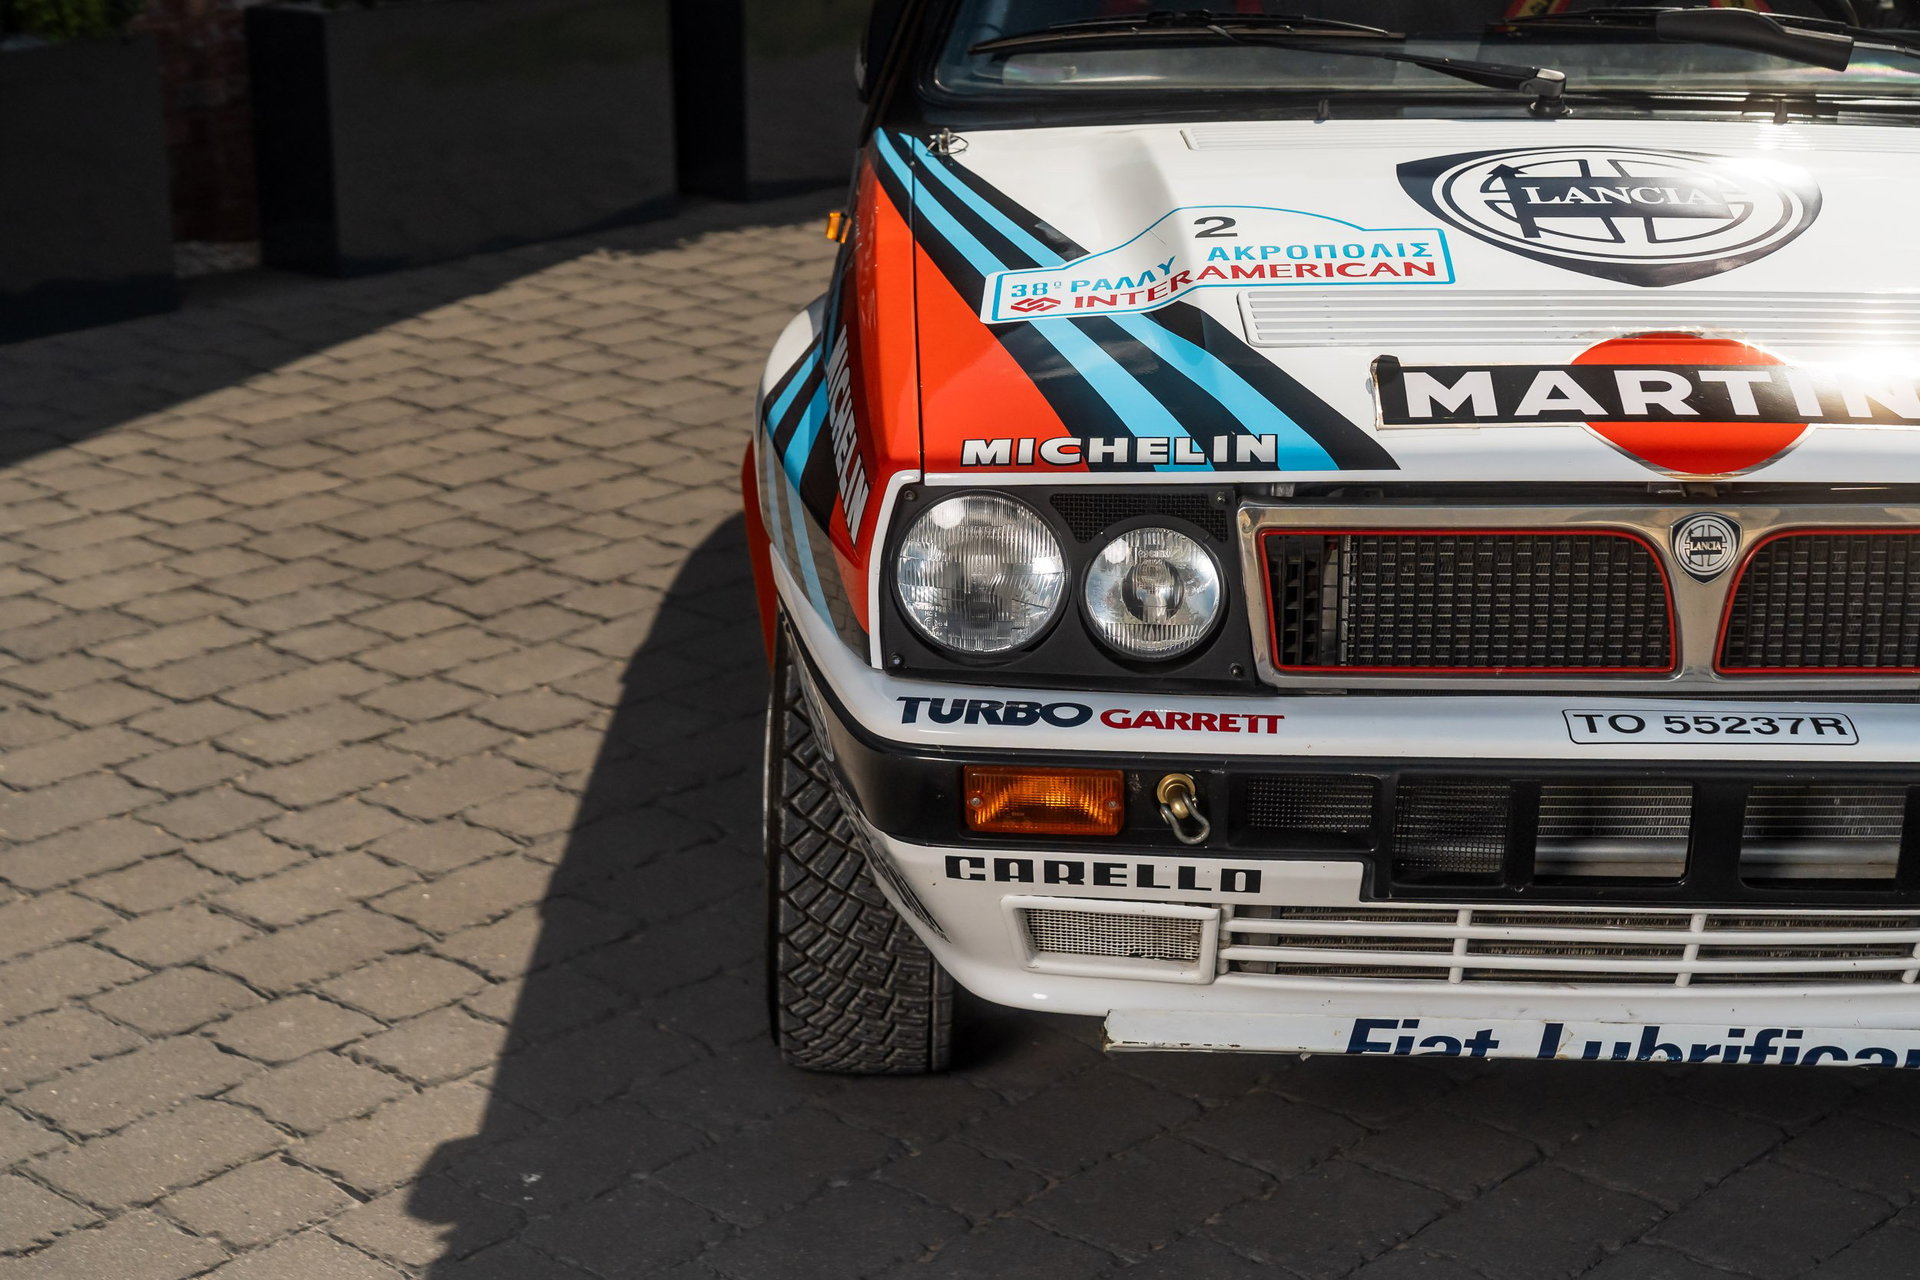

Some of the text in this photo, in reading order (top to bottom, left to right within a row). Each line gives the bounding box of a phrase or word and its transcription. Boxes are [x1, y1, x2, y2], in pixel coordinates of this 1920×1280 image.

[1521, 185, 1728, 205] LANCIA
[1194, 215, 1238, 238] 2
[1074, 261, 1436, 309] INTERAMERICAN
[825, 322, 870, 546] MICHELIN
[960, 433, 1278, 467] MICHELIN
[1689, 541, 1722, 552] LANCIA
[896, 696, 1285, 735] TURBO GARRETT
[1573, 714, 1849, 736] TO 55237R
[945, 855, 1262, 894] CARELLO
[1345, 1018, 1500, 1058] Fiat
